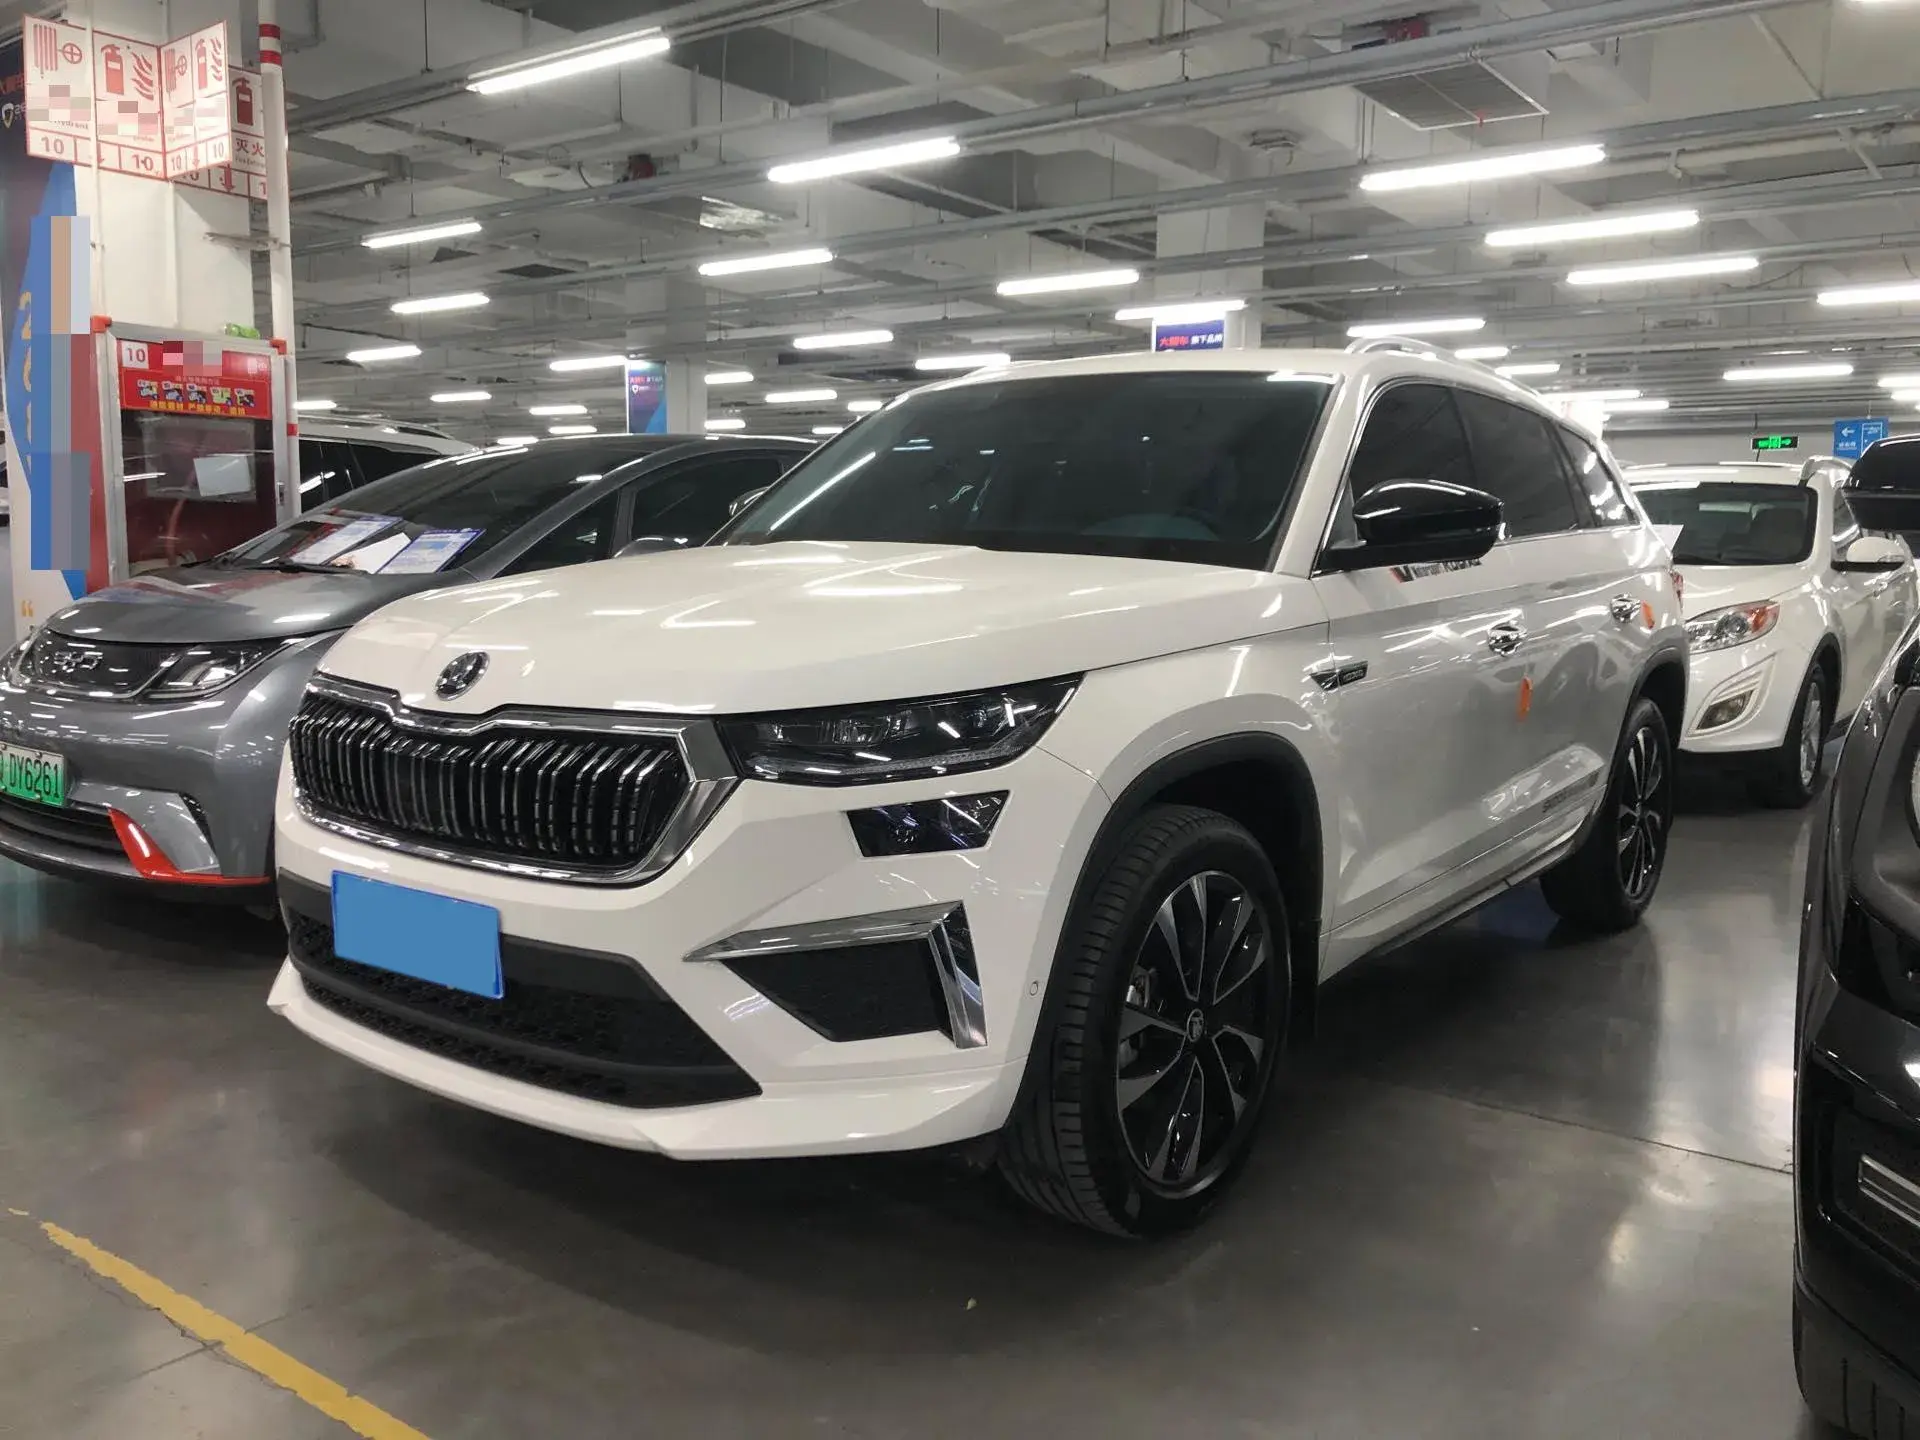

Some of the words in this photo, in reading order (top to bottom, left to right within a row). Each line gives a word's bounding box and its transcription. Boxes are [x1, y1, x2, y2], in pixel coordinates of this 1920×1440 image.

[41, 136, 64, 155] 10
[213, 141, 224, 158] 10
[132, 154, 154, 172] 10
[171, 154, 182, 171] 10
[126, 347, 146, 363] 10
